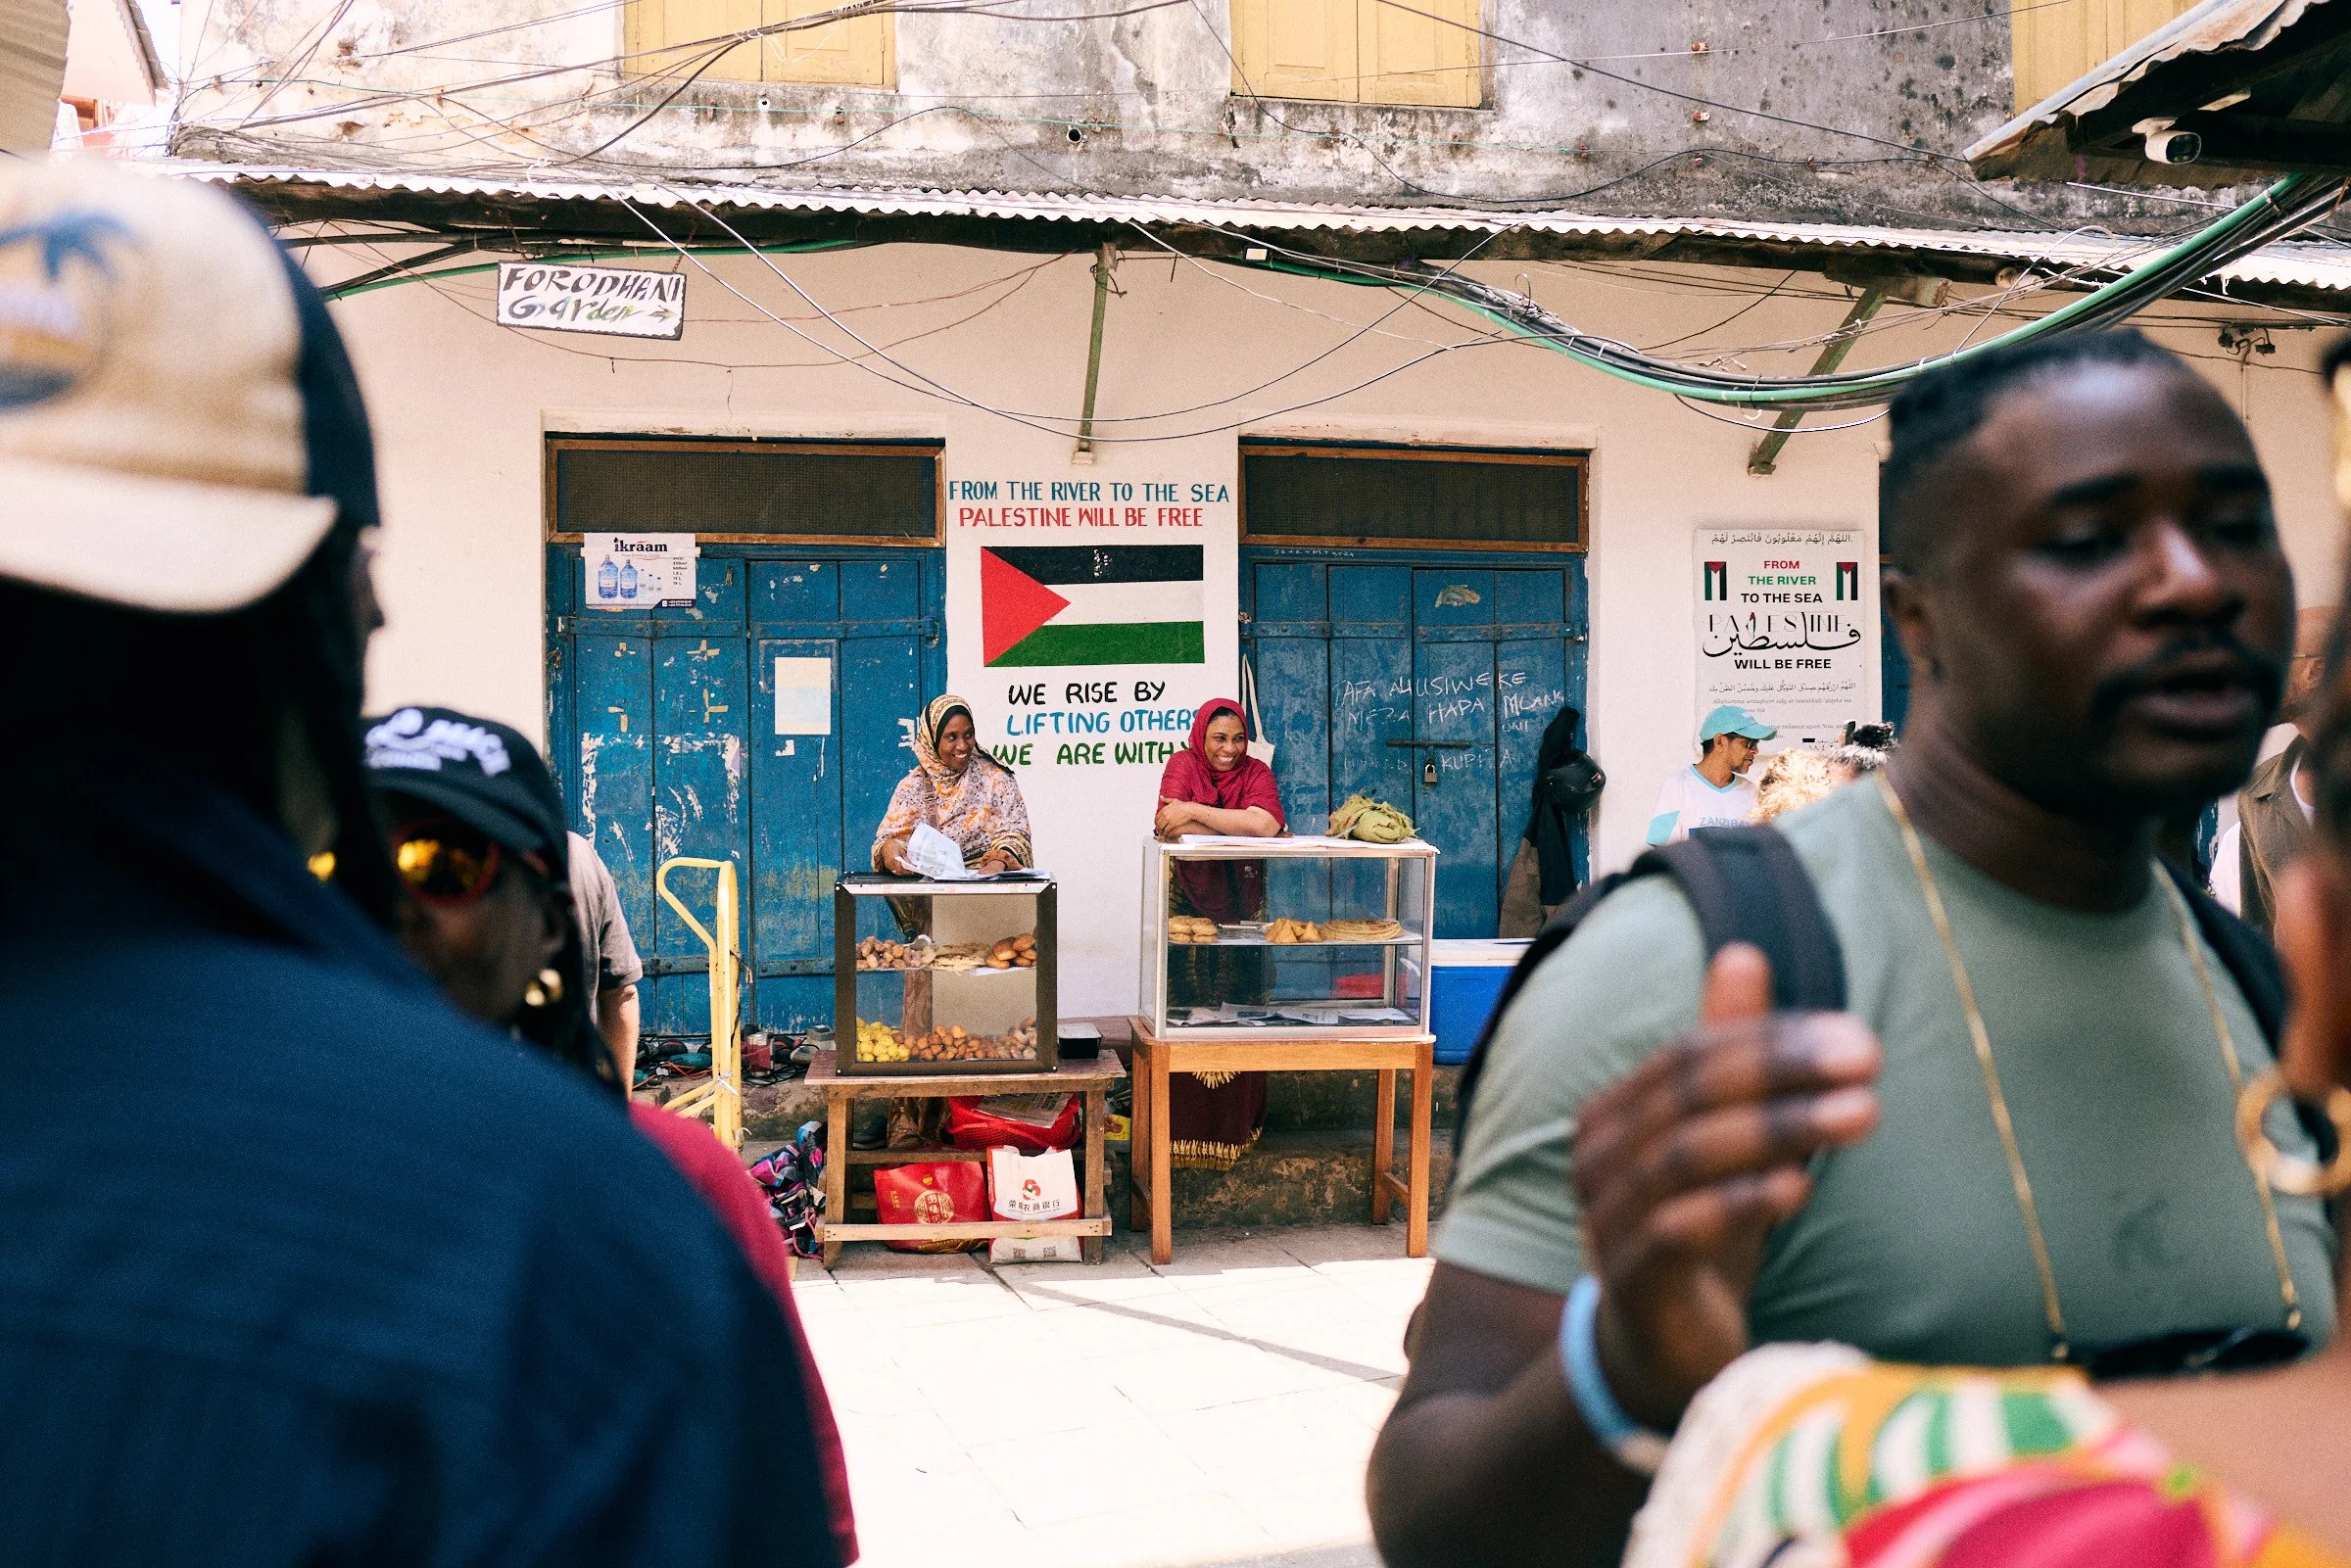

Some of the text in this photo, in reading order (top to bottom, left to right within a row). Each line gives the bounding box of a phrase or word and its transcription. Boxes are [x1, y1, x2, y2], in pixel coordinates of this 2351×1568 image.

[503, 267, 681, 302] FORODHANI
[949, 481, 1230, 503] FROM THE RIVER TO THE SEA
[959, 507, 1204, 527] PALESTINE WILL BE FREE
[613, 537, 668, 552] ikraam
[1763, 560, 1800, 569] FROM
[1748, 576, 1816, 585] THE RIVER
[1741, 594, 1823, 603] TO THE SEA
[1735, 659, 1832, 669] WILL BE FREE
[1008, 681, 1166, 706] WE RISE BY
[1428, 696, 1484, 724] HAPA
[1007, 711, 1110, 736] LIFTING
[992, 743, 1033, 766] WE
[1056, 742, 1106, 765] ARE
[1115, 740, 1175, 764] WITH
